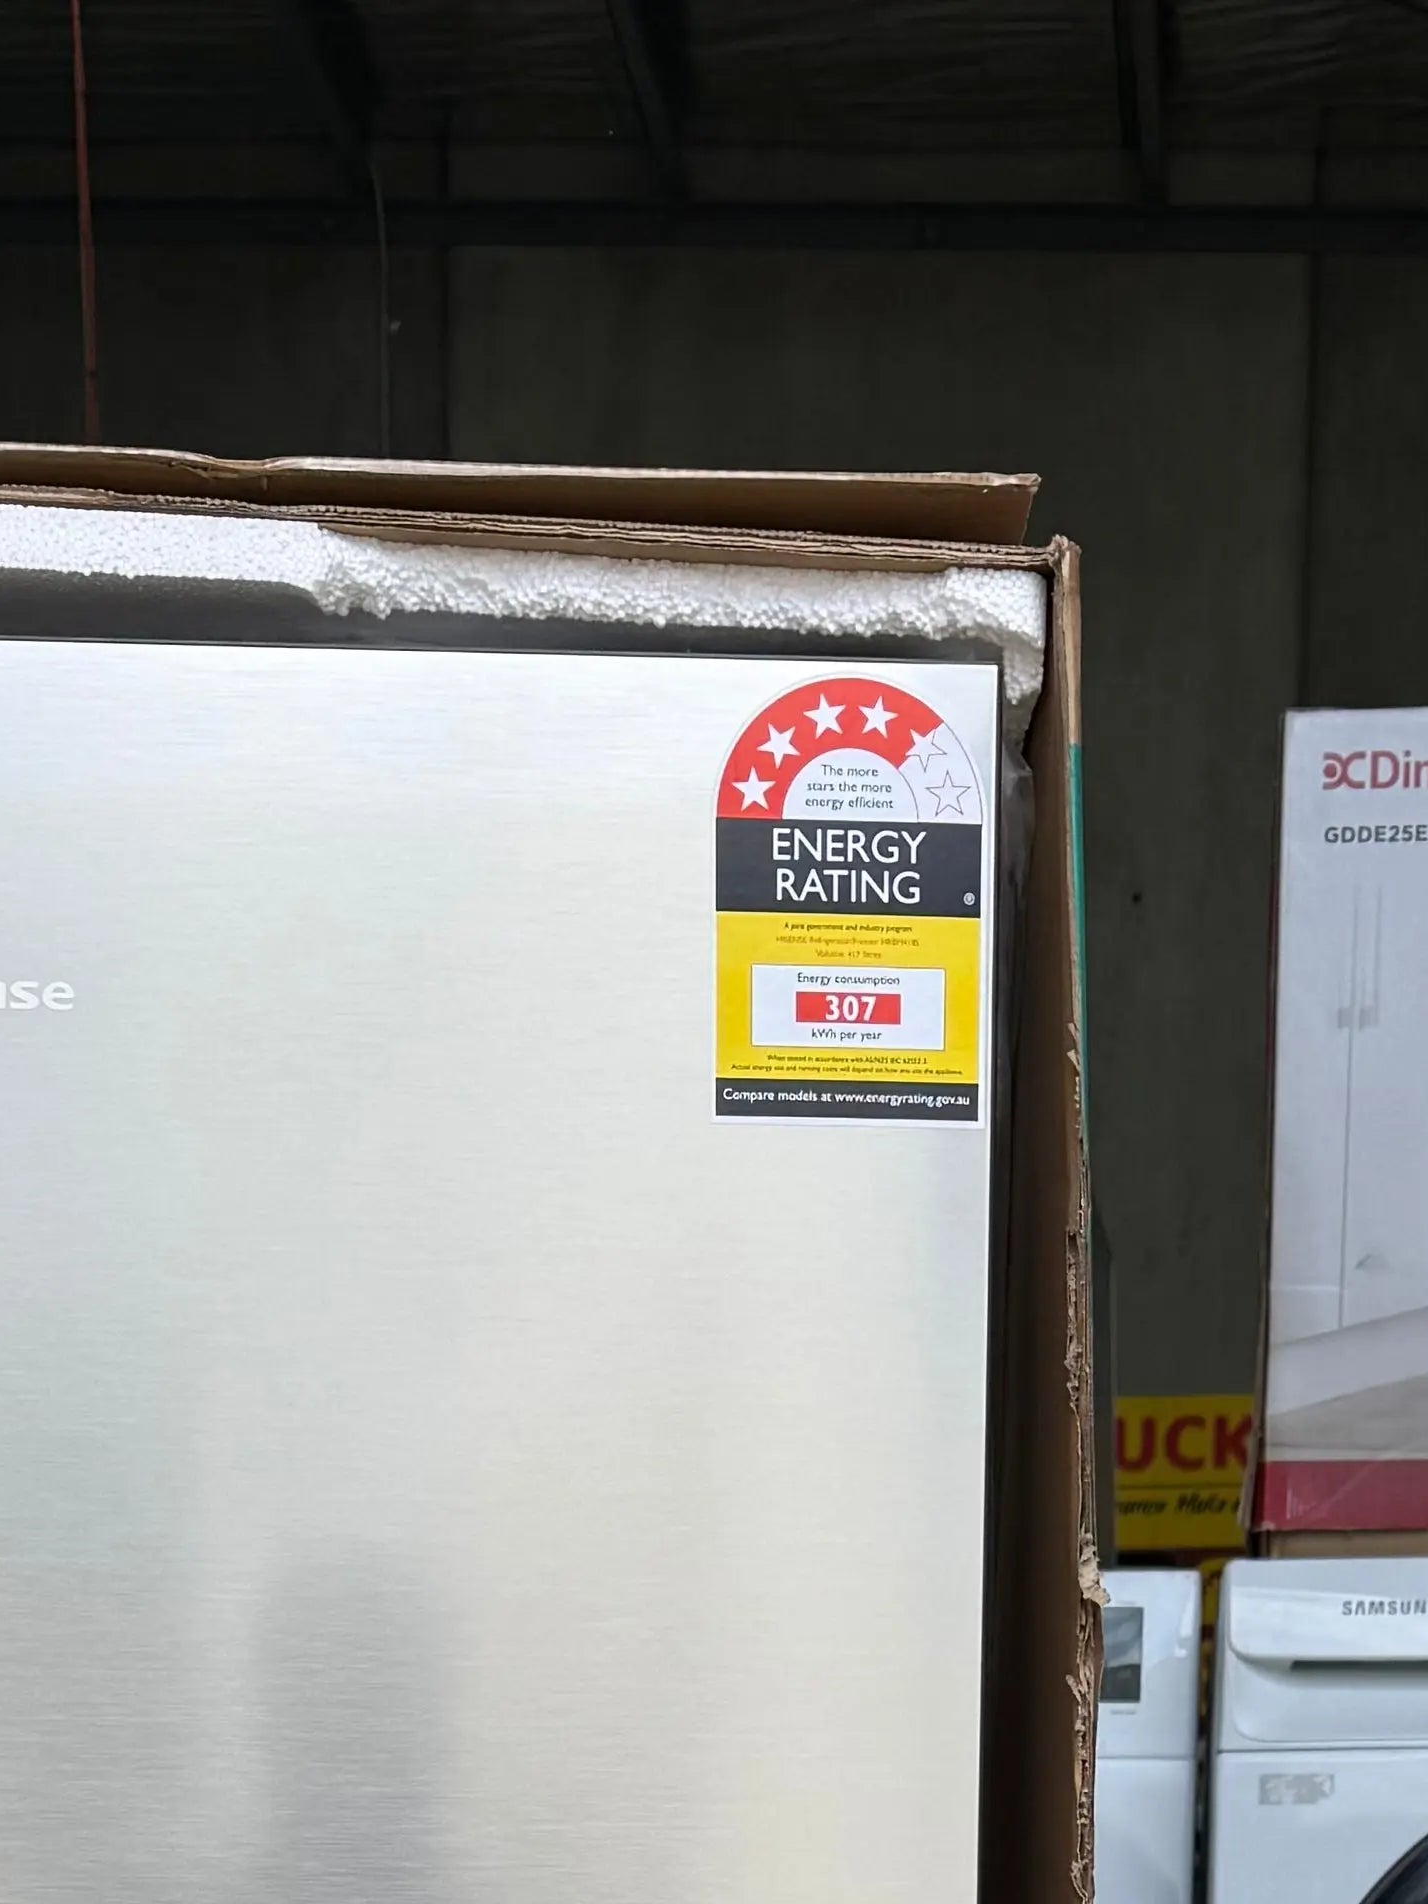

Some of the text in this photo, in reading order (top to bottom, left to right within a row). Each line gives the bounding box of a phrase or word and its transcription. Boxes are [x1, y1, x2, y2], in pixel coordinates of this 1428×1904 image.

[821, 764, 879, 777] The more
[807, 781, 893, 793] stars the more
[805, 797, 894, 811] energy efficient
[1324, 824, 1428, 844] GDDE25E
[772, 828, 927, 864] ENERGY
[776, 868, 921, 904] RATING
[797, 972, 900, 986] Energy consumption
[825, 995, 876, 1021] 307
[812, 1028, 882, 1042] kWh per year
[723, 1088, 970, 1107] Compare models at www.energyrating.gov.au
